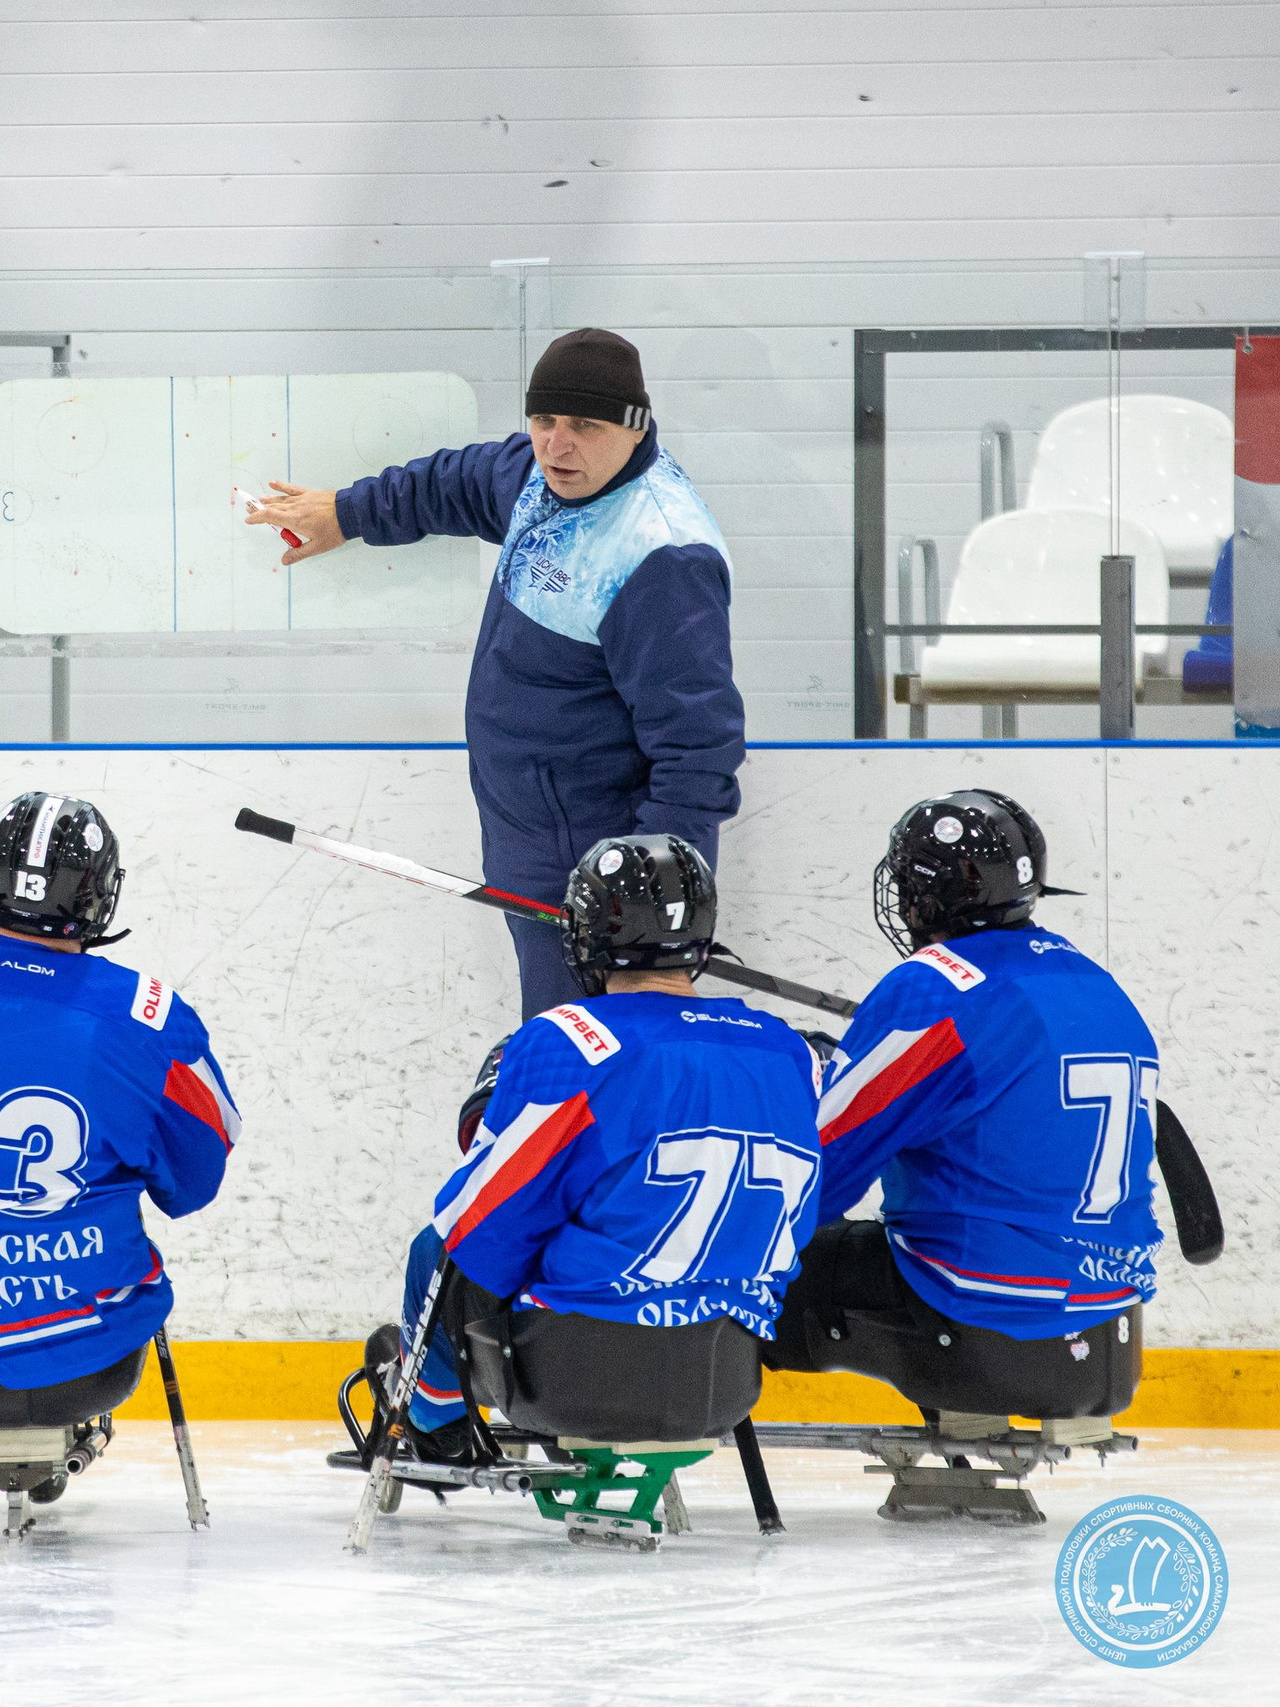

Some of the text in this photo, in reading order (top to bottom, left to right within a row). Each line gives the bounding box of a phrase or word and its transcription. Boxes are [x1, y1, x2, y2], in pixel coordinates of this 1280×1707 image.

[1016, 855, 1034, 884] 8
[14, 870, 47, 901] 13
[666, 901, 685, 931] 7
[925, 949, 976, 981] PBET
[143, 977, 163, 1020] OLIM
[556, 1008, 609, 1052] MPBET
[696, 1013, 763, 1029] SLALOM
[622, 1126, 821, 1286] 77
[1118, 1316, 1129, 1343] 8
